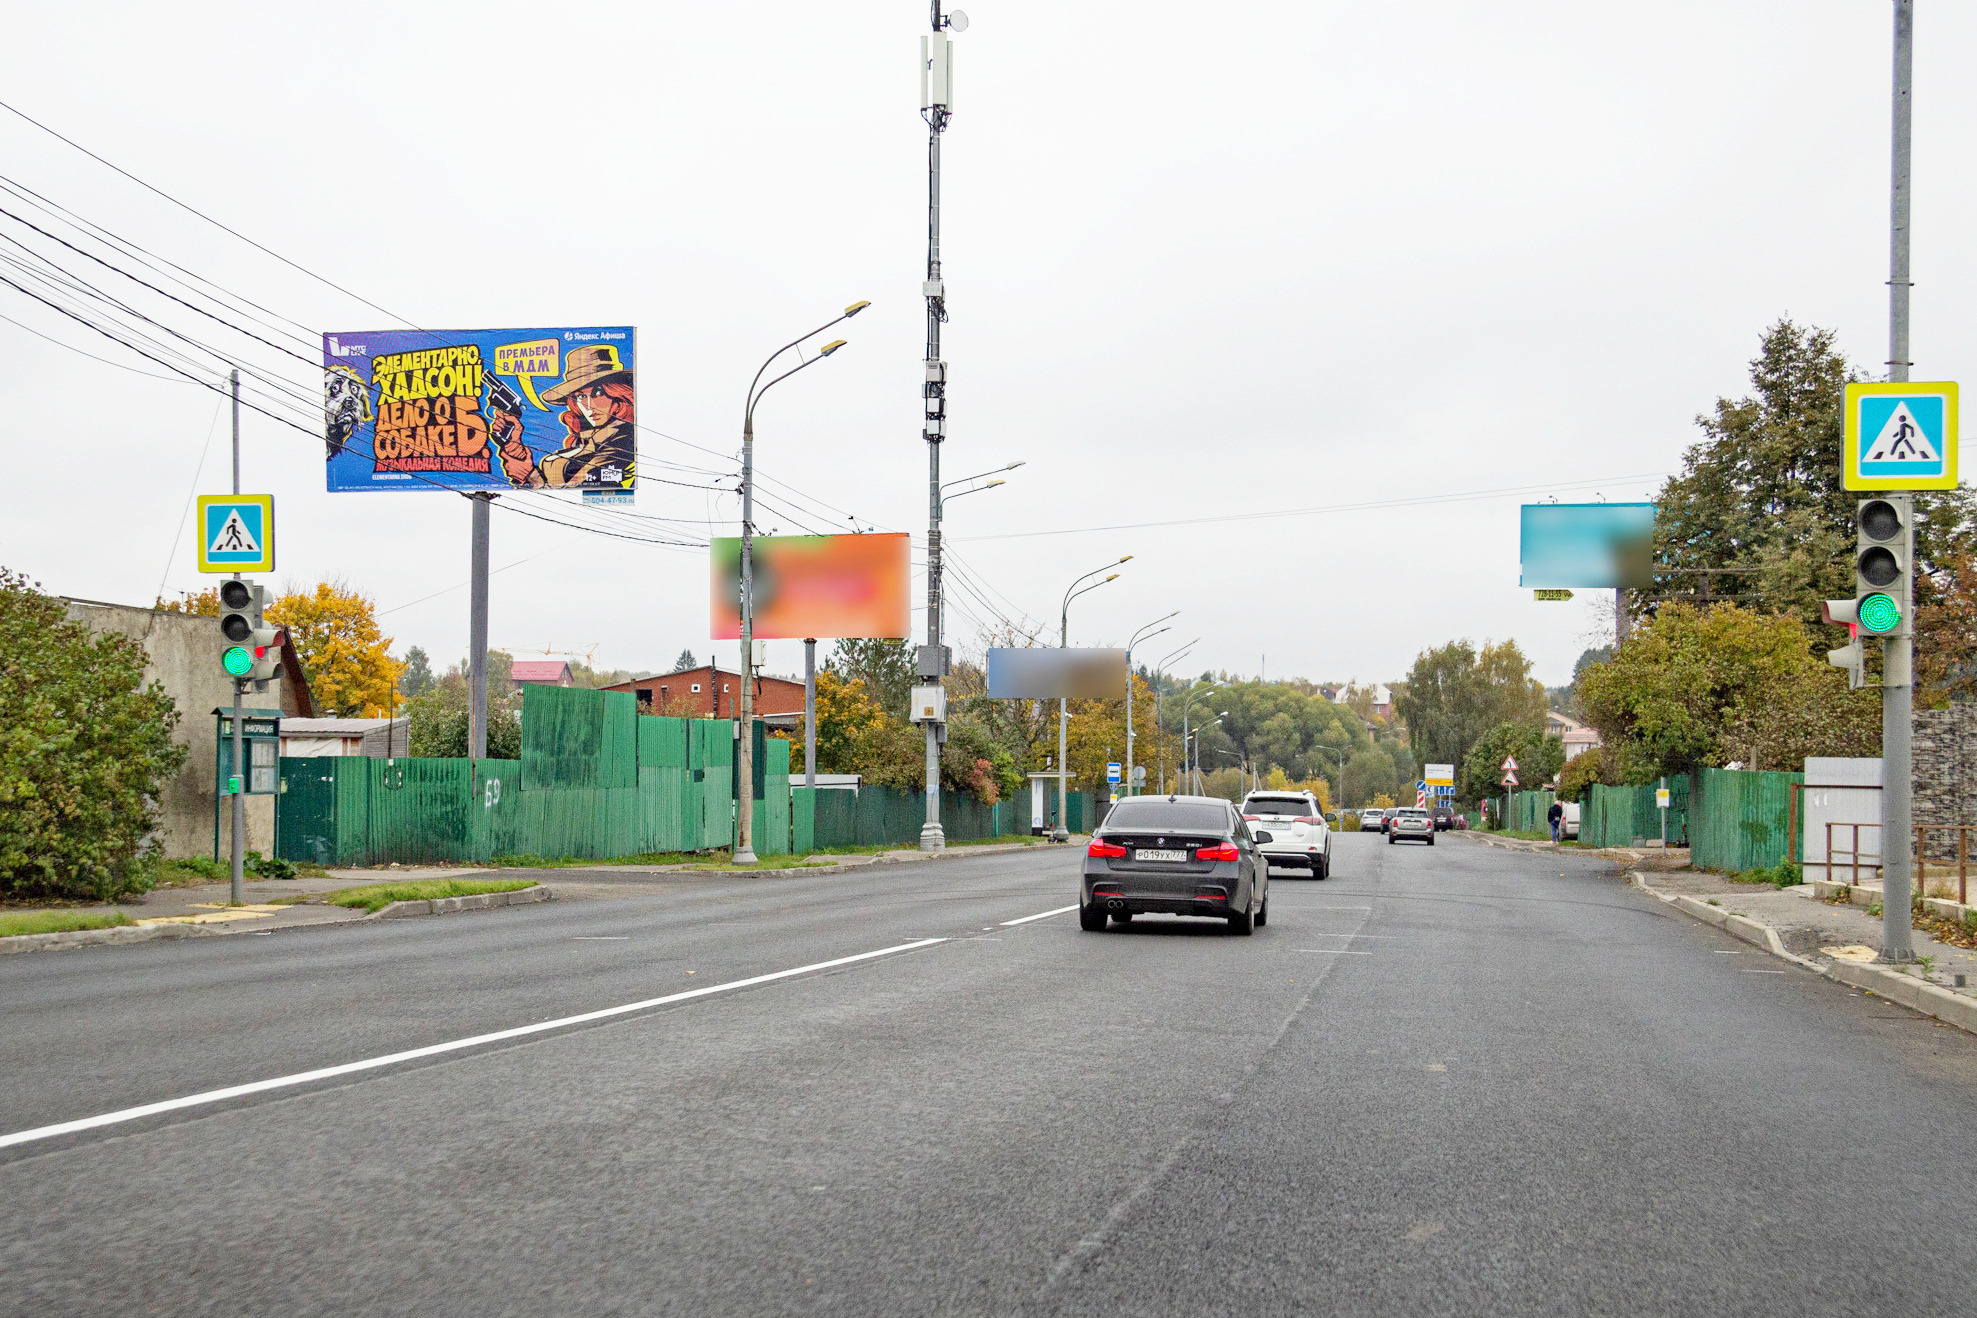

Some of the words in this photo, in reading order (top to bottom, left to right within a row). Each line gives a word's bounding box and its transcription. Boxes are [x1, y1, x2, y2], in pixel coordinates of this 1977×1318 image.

[574, 333, 599, 341] Яндекс
[600, 332, 626, 340] Афиша
[499, 345, 556, 360] ПРЕМЬЕРА
[372, 345, 482, 378] ЭЛЕМЕНТАРНО,
[513, 359, 550, 373] МДМ
[378, 365, 482, 405] ХАДСОН!
[375, 398, 430, 431] ДЕЛО
[434, 396, 451, 425] О
[374, 425, 458, 459] СОБАКЕ
[375, 458, 442, 472] МУЗЫКАЛЬНАЯ
[442, 457, 489, 473] КОМЕДИЯ
[585, 473, 597, 482] 12+
